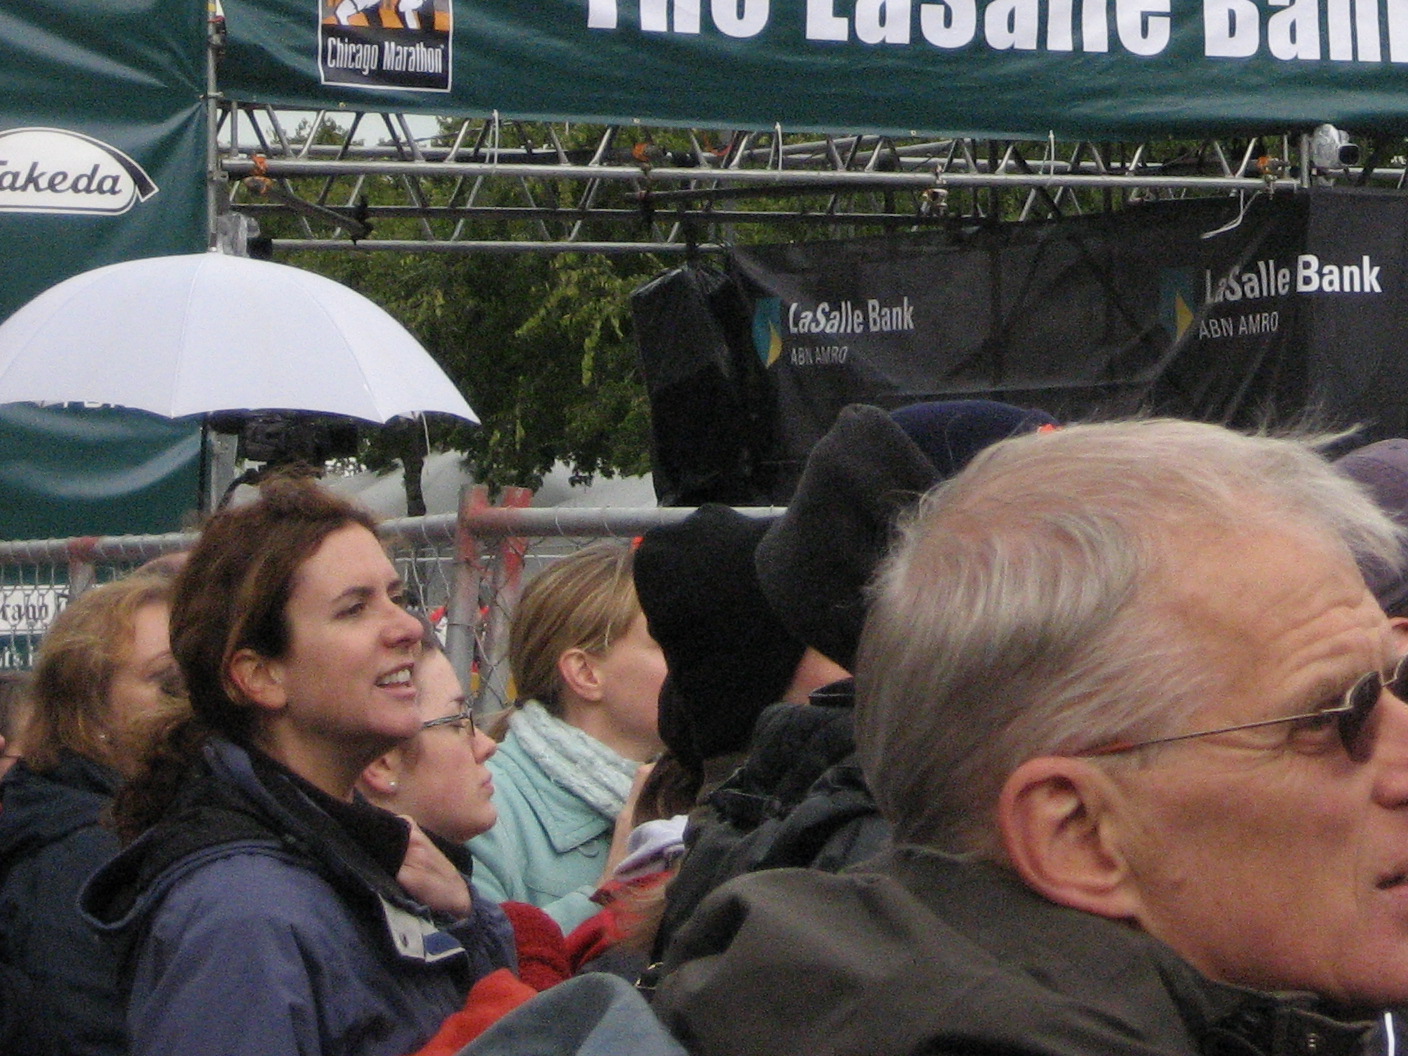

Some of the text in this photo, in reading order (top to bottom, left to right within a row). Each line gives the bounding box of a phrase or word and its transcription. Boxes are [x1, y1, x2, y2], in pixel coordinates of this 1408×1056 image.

[327, 37, 444, 75] Chicago Marathon
[1205, 254, 1382, 304] LaSalle Bank
[788, 297, 914, 335] LaSalle Bank
[1199, 311, 1279, 340] ABN AMRO
[789, 345, 849, 366] ABN AMRO
